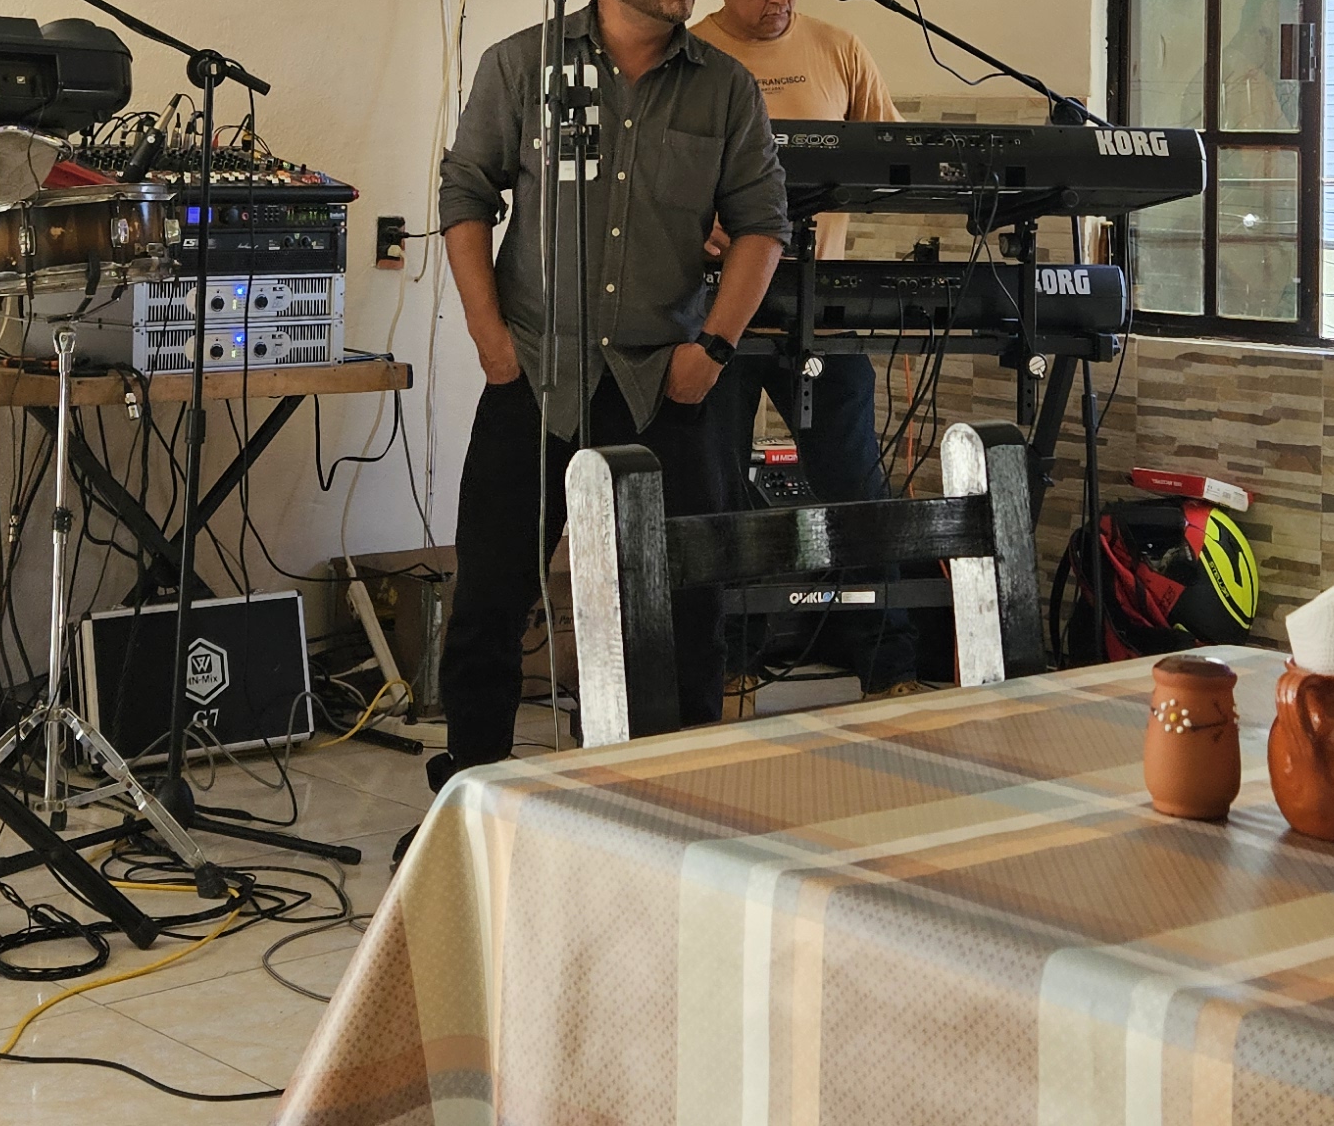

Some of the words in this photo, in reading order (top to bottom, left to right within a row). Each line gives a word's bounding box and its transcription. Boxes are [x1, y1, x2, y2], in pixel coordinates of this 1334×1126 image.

[756, 75, 806, 87] FRANCISCO
[1094, 130, 1169, 157] KORG
[192, 708, 219, 728] G7
